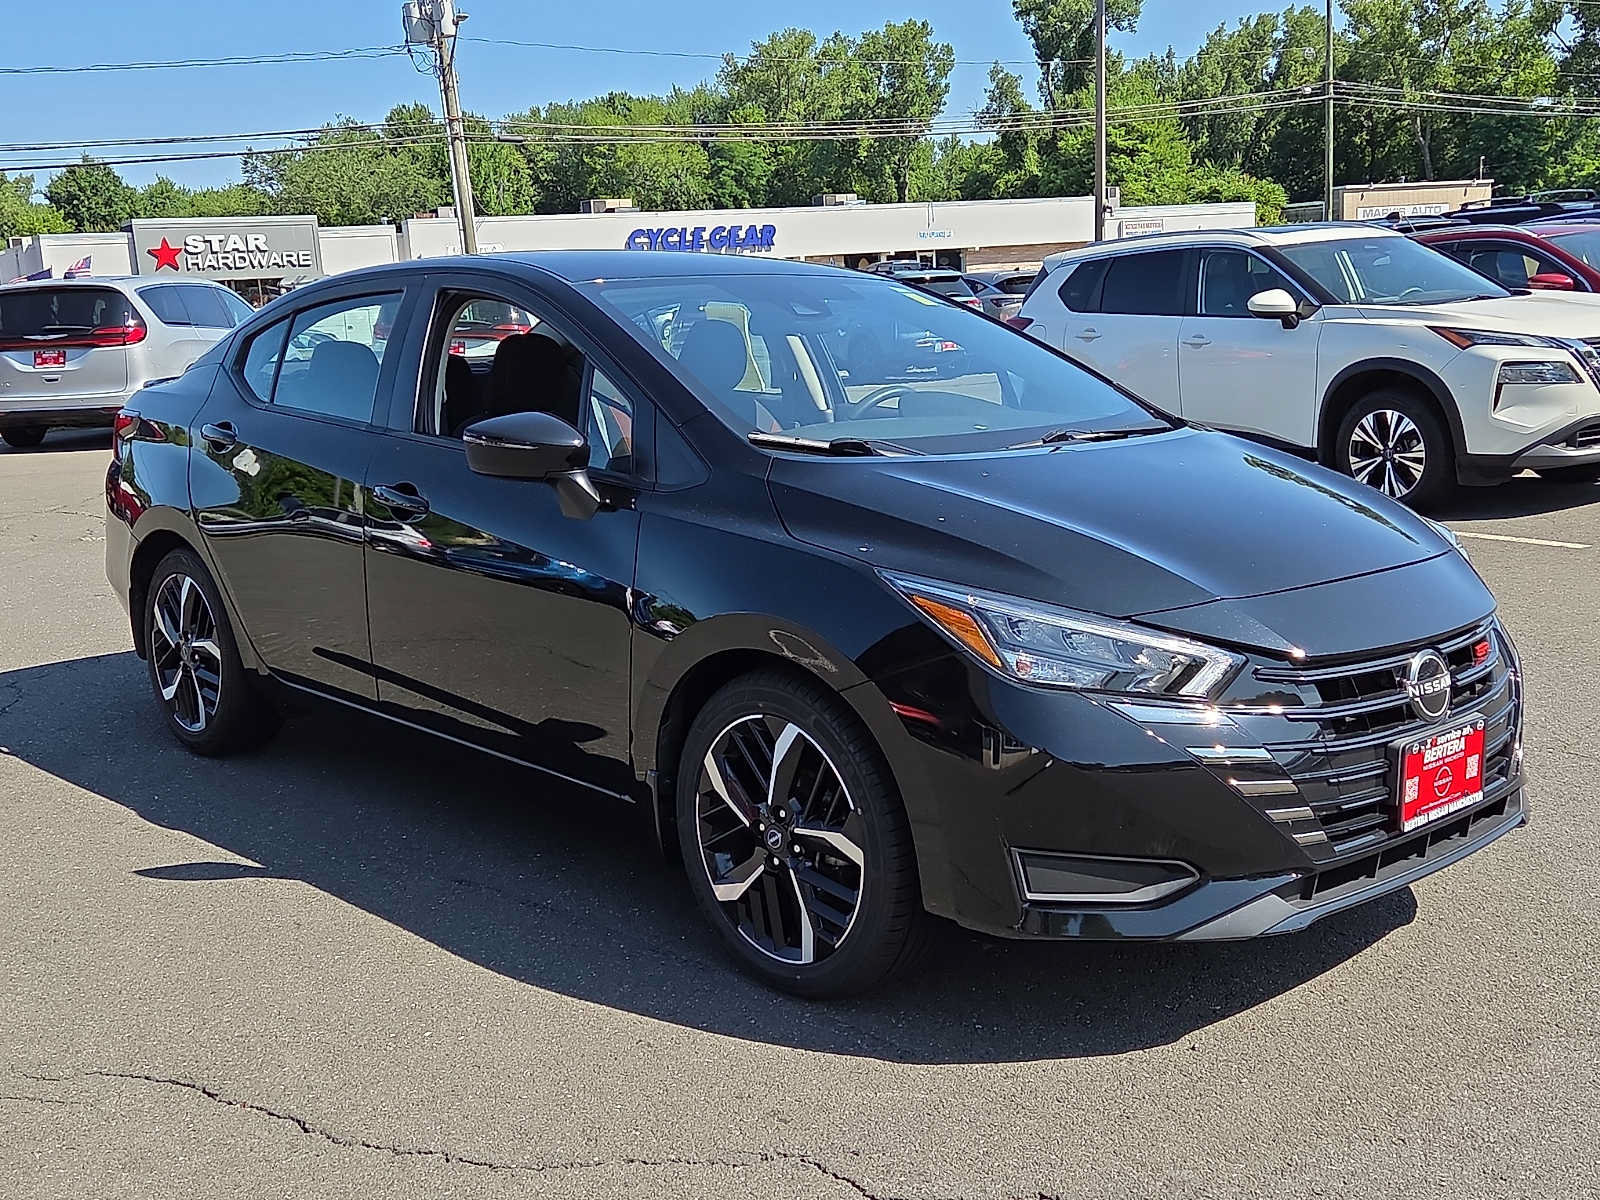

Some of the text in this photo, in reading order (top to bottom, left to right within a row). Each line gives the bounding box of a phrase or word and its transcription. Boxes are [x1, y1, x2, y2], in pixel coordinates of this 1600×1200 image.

[1411, 205, 1442, 215] AUTO
[184, 233, 269, 254] STAR
[627, 224, 776, 252] CYCLE GEAR
[186, 250, 313, 271] HARDWARE
[1407, 674, 1452, 698] NISSAN
[1423, 736, 1466, 764] BERTERA
